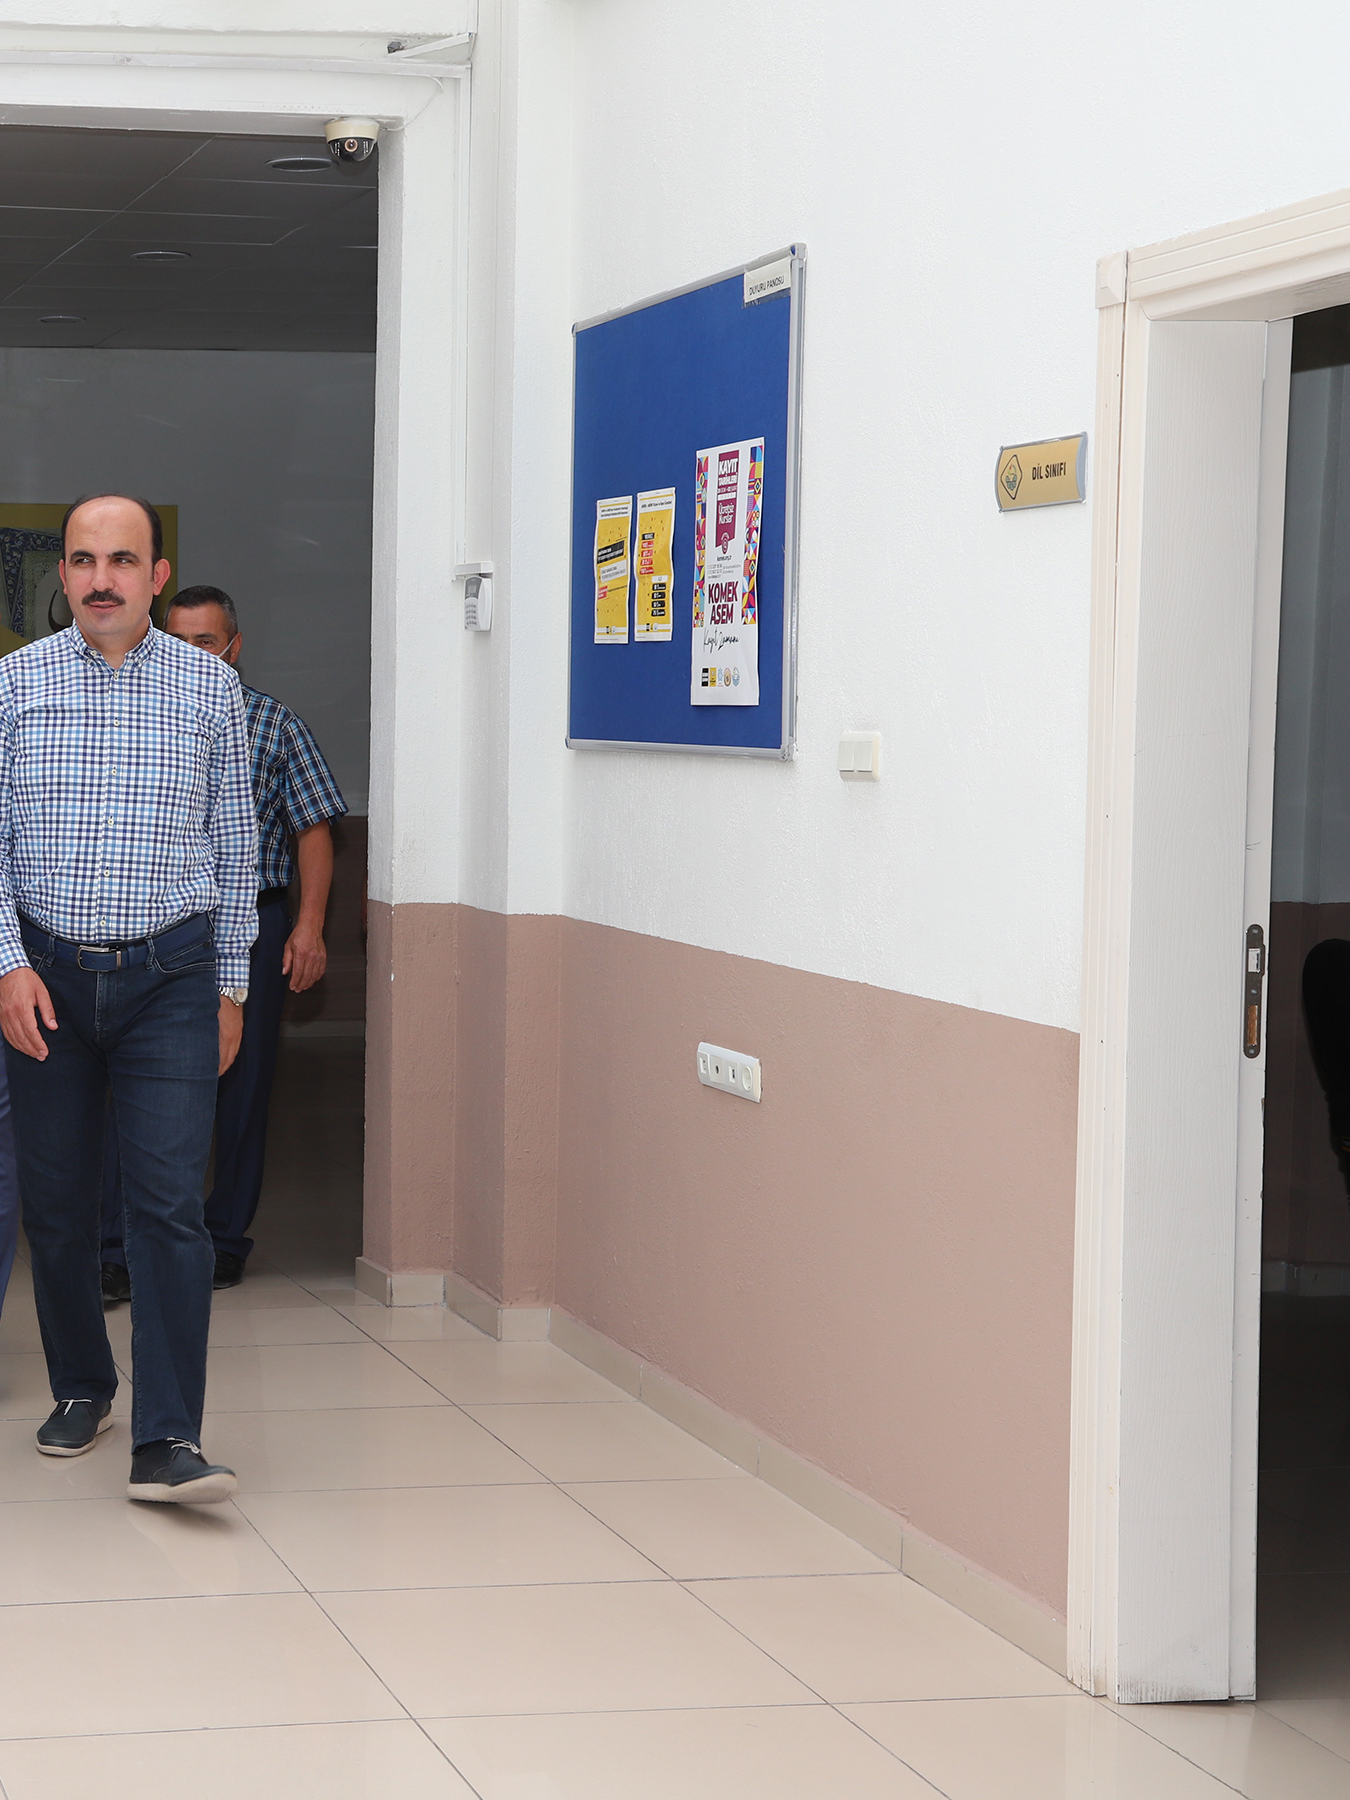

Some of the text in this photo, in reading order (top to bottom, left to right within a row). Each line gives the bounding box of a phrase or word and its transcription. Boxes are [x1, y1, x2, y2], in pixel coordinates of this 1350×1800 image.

[749, 275, 784, 296] DUYURU PANOSU
[718, 459, 738, 475] KAYIT
[1032, 462, 1066, 480] DİL SINIFI
[708, 581, 739, 604] KOMEK
[710, 603, 734, 625] ASEM
